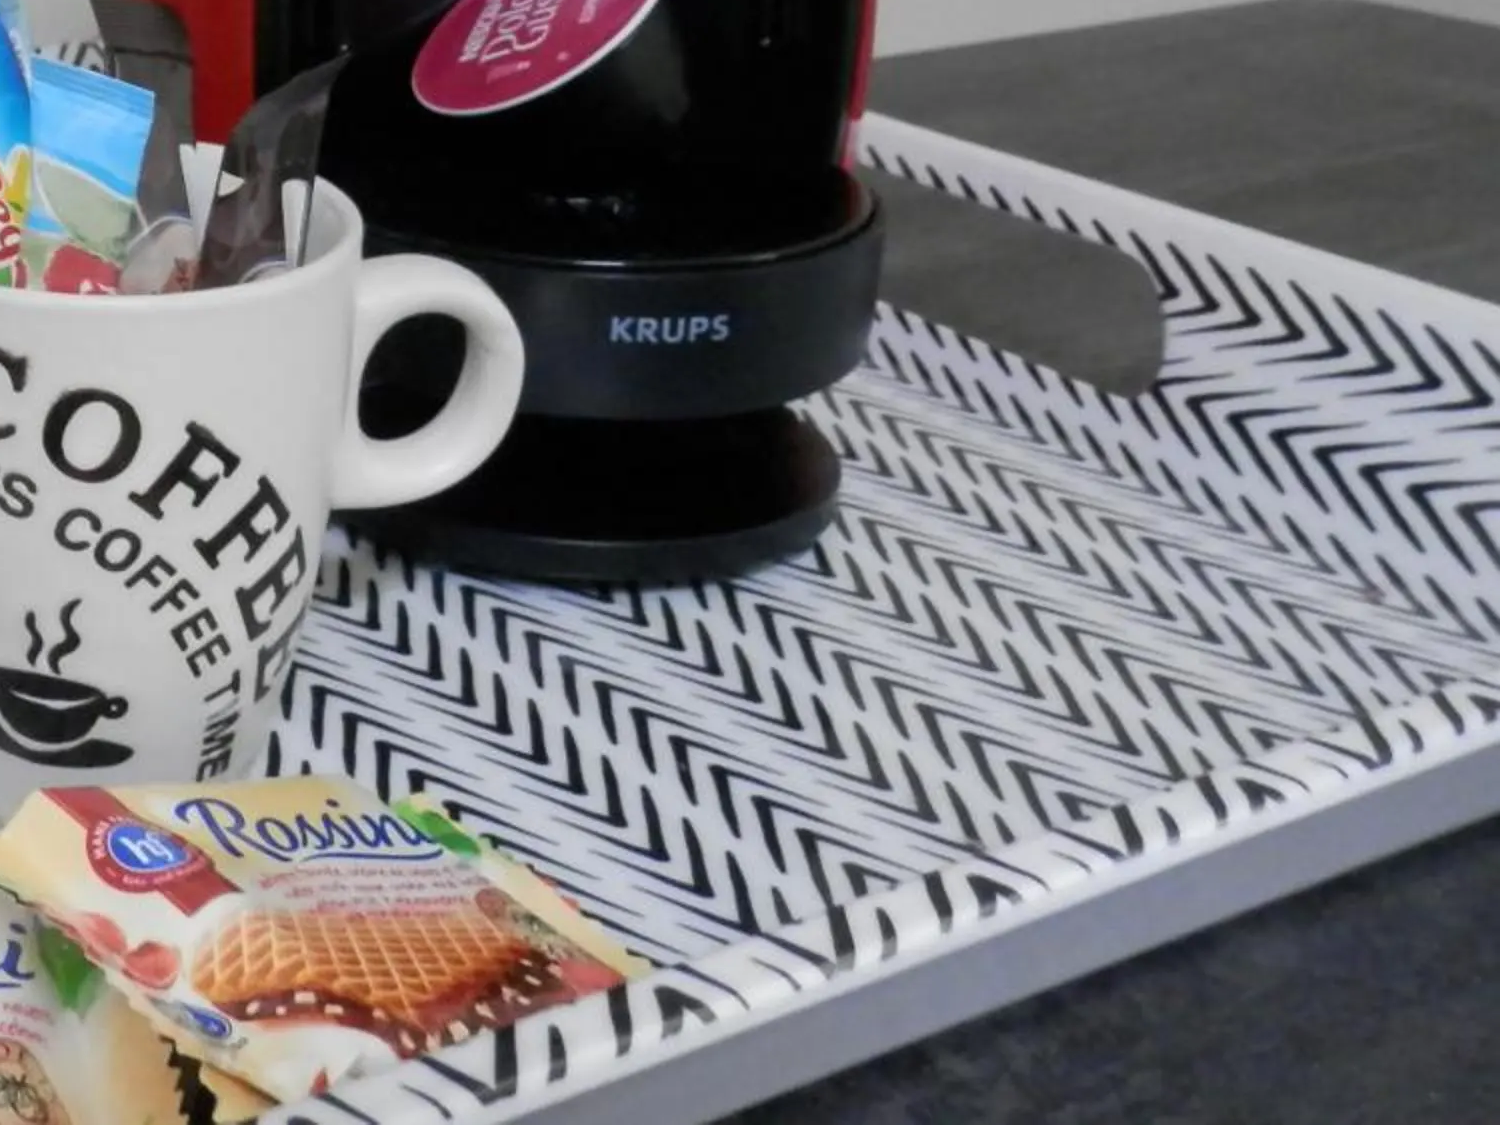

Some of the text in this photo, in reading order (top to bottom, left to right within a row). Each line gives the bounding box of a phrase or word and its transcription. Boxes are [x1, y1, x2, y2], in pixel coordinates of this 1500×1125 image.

[609, 315, 731, 344] KRUPS
[53, 507, 233, 678] COFFEE
[195, 668, 241, 782] TIME
